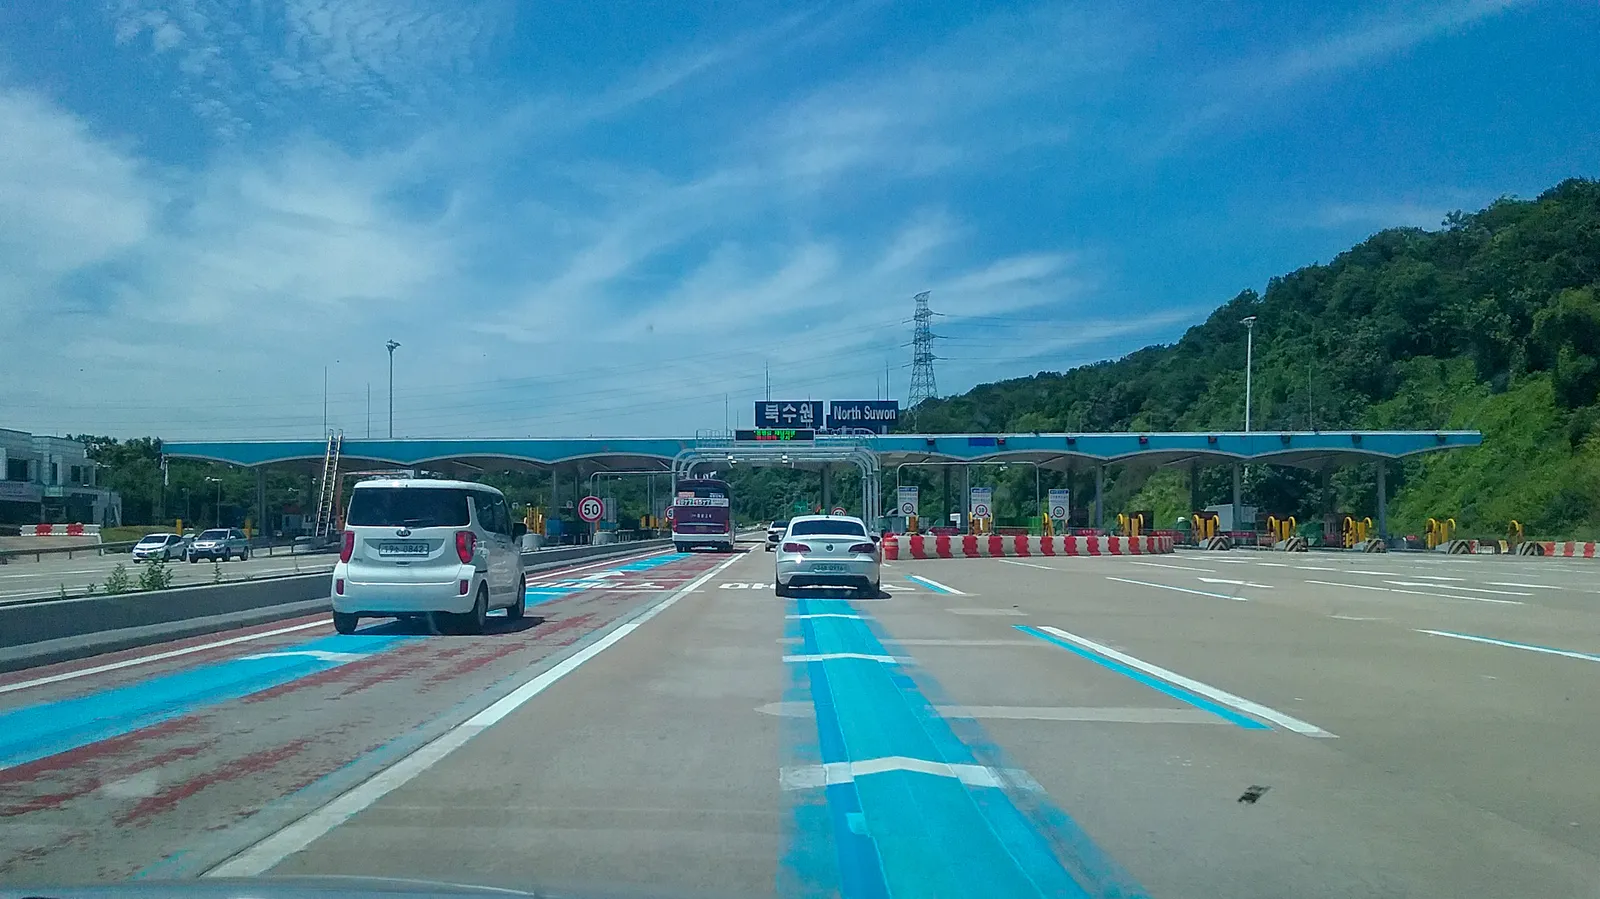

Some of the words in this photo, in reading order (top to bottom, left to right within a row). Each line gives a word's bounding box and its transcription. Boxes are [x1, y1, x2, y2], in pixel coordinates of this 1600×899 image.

[764, 403, 814, 423] 북수원
[833, 405, 861, 420] North
[864, 405, 896, 420] Suwon
[583, 504, 599, 516] 50
[403, 545, 424, 553] 0842
